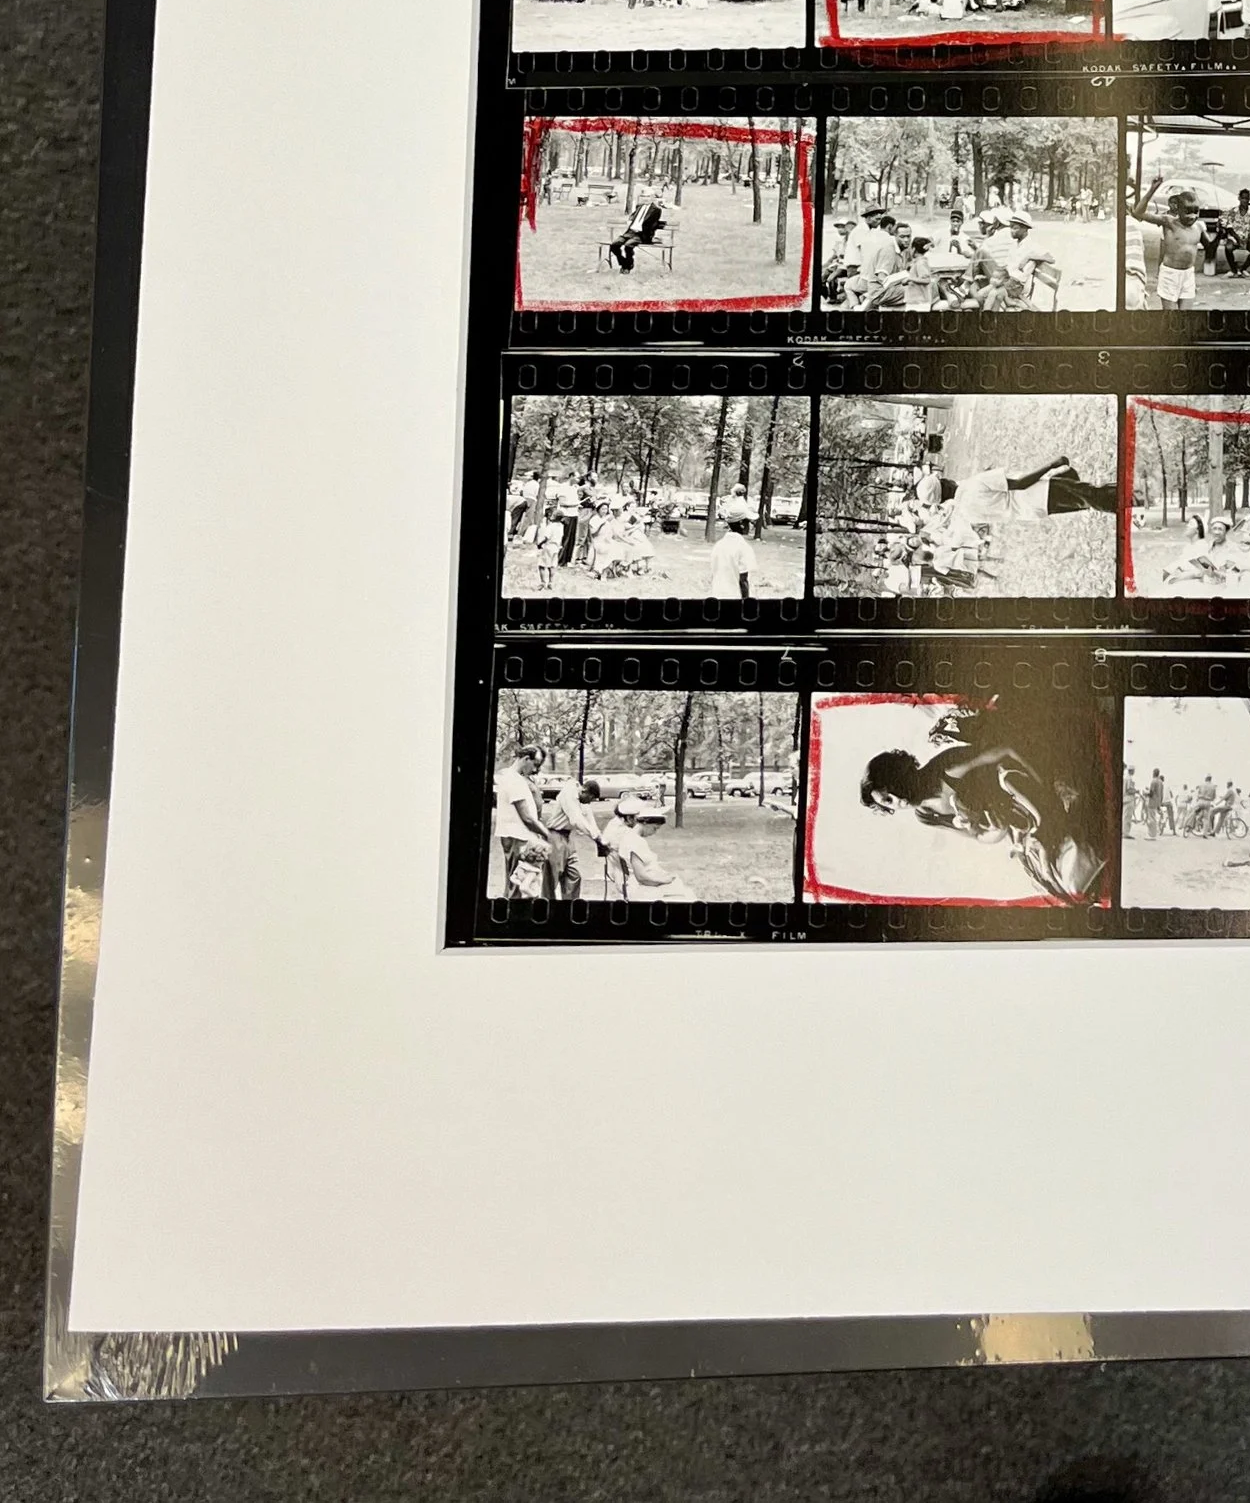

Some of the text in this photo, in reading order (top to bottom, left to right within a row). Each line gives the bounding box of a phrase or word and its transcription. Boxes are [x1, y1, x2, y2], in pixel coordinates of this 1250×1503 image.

[1082, 64, 1122, 72] KODAK
[1090, 76, 1116, 87] 42
[787, 335, 827, 343] KODAK
[792, 352, 804, 367] 2
[1097, 350, 1111, 365] 3
[771, 930, 807, 940] FILM
